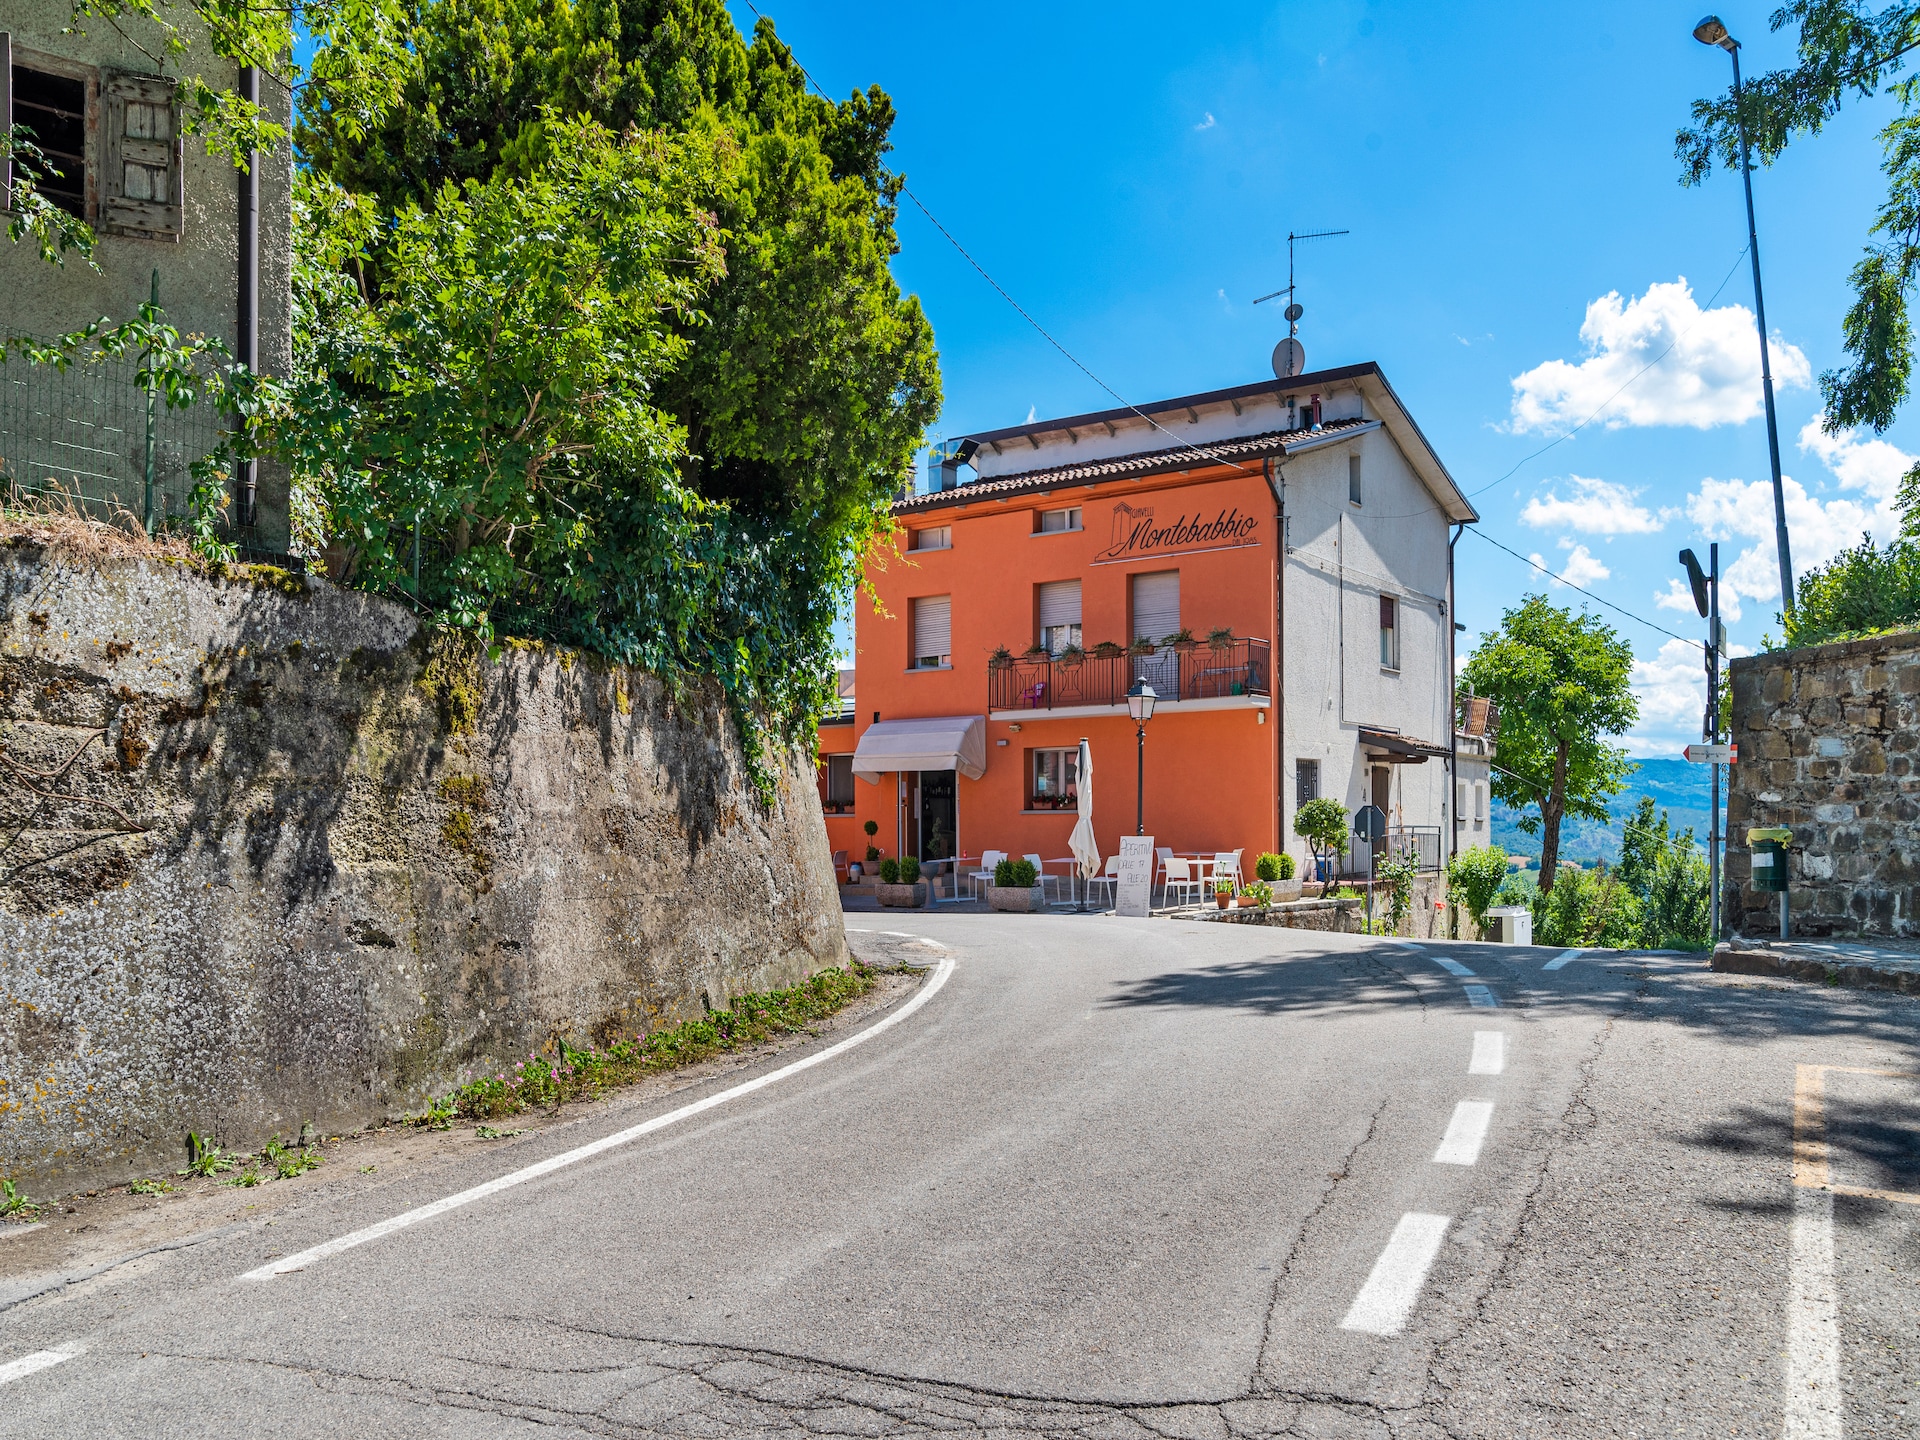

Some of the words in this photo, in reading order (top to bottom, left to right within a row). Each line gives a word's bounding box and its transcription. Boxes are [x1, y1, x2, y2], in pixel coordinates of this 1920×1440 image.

[1131, 506, 1154, 519] GIAVELLI
[1108, 507, 1258, 556] Montebabbio
[1119, 859, 1135, 870] DALLE
[1127, 872, 1140, 884] ALLE
[1140, 874, 1149, 883] 20
